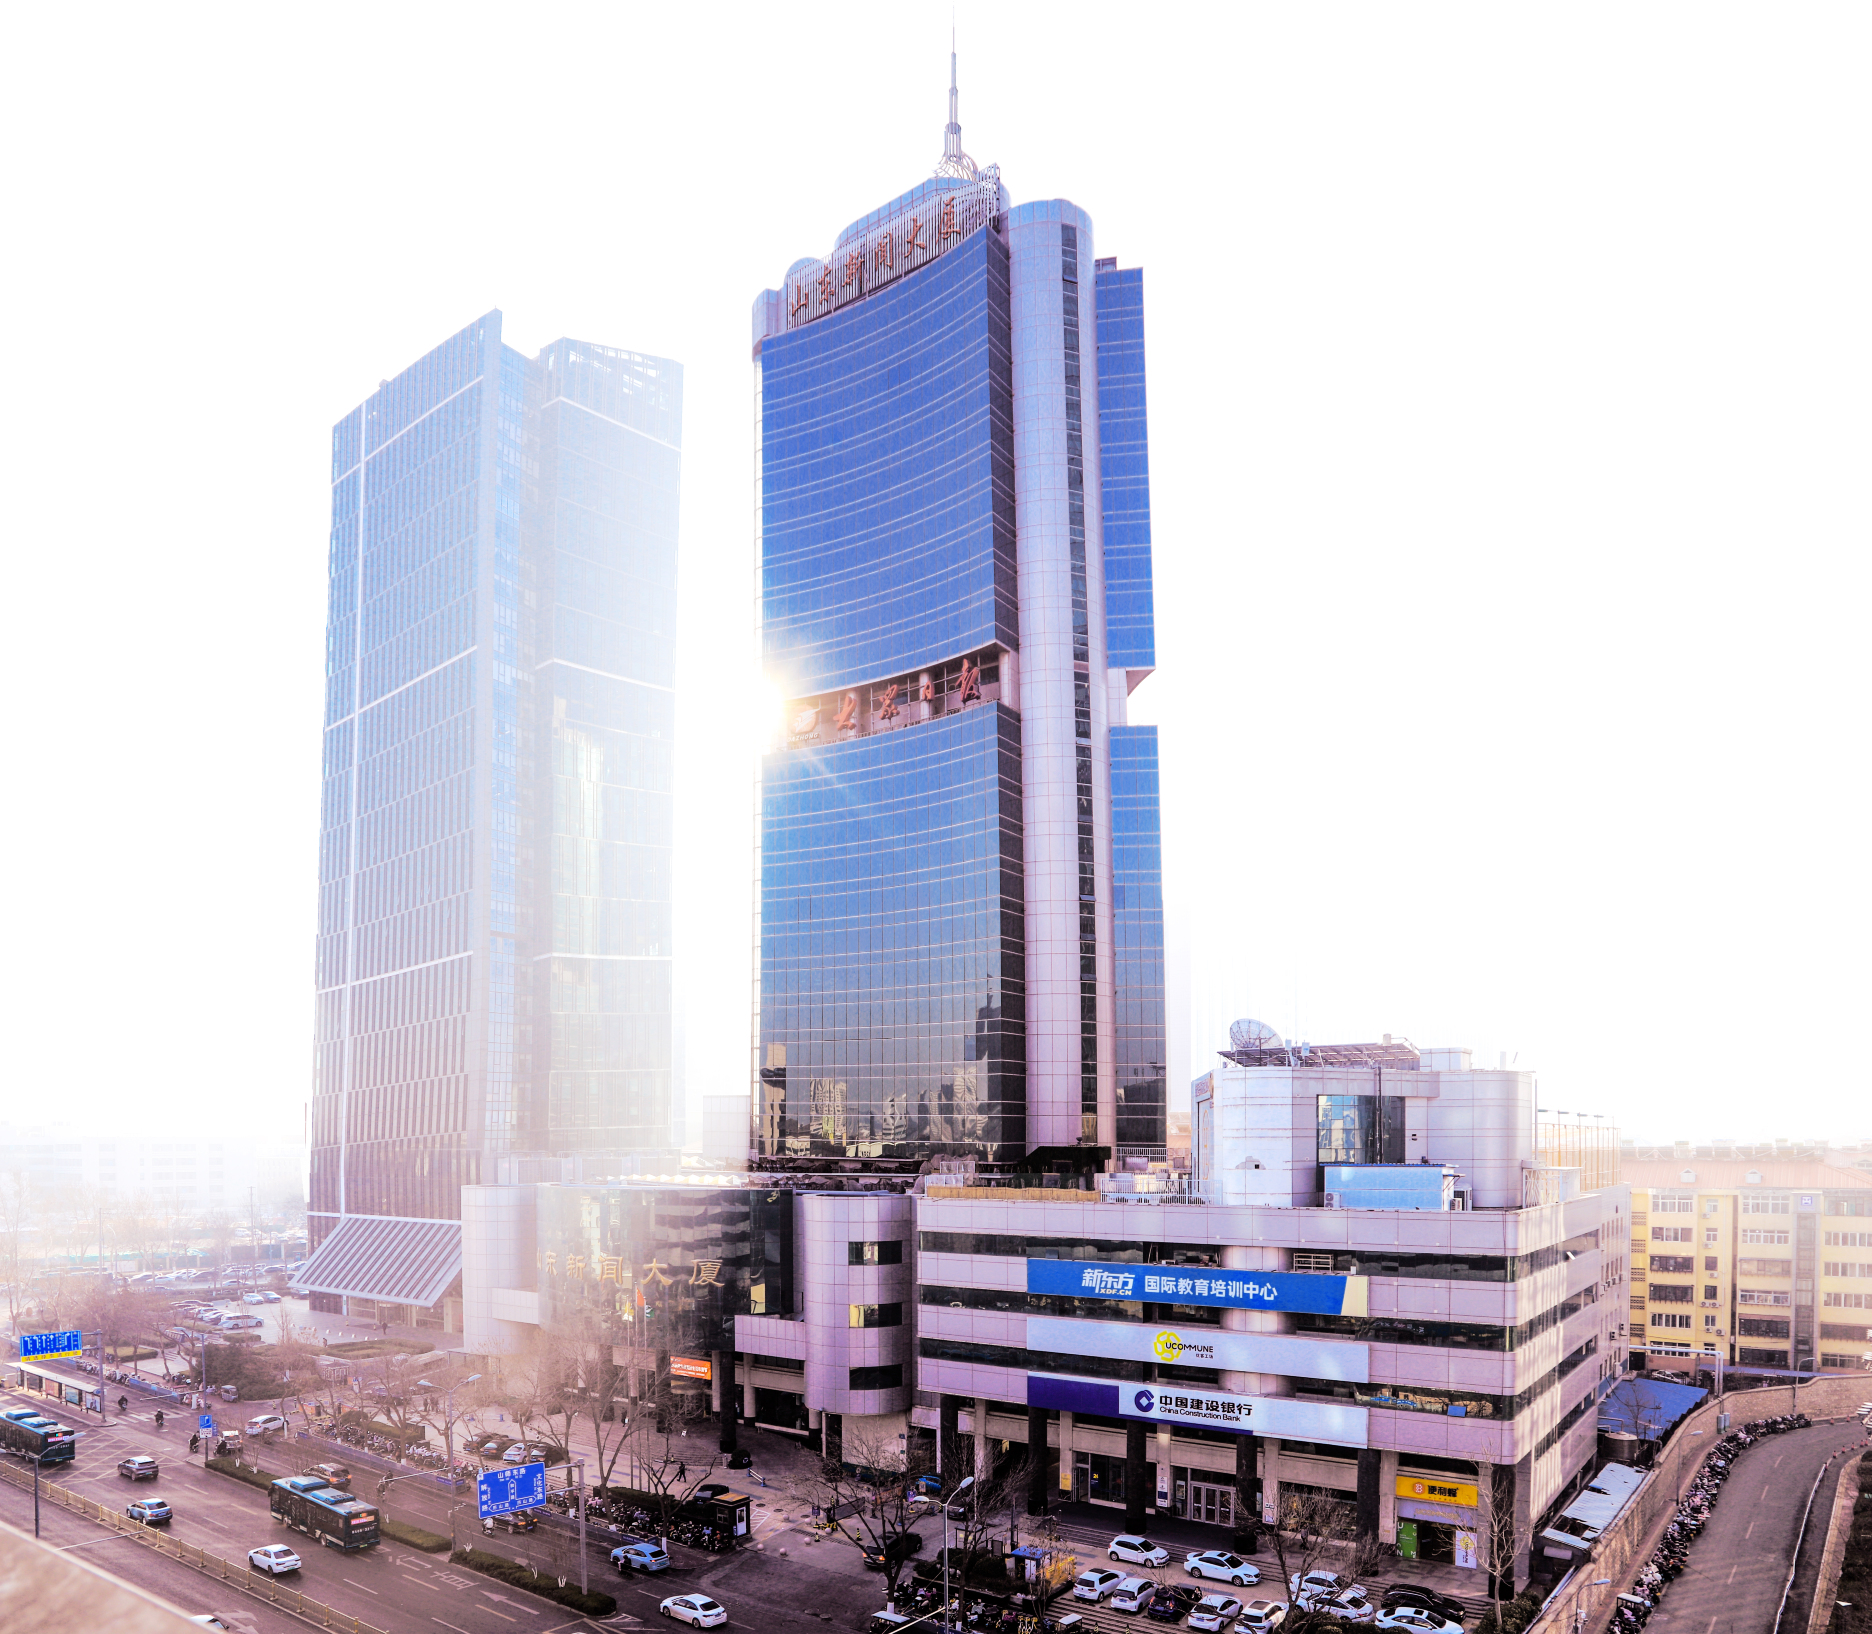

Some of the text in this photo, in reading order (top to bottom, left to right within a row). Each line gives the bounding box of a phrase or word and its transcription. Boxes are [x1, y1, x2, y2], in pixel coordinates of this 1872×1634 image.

[1082, 1268, 1278, 1301] 新东方 国际教育培训中心
[1099, 1288, 1132, 1296] XDF.CN
[1165, 1342, 1214, 1353] UCOMMUNE
[1159, 1395, 1253, 1416] 中国建设银行
[1159, 1406, 1241, 1422] China Construction Bank
